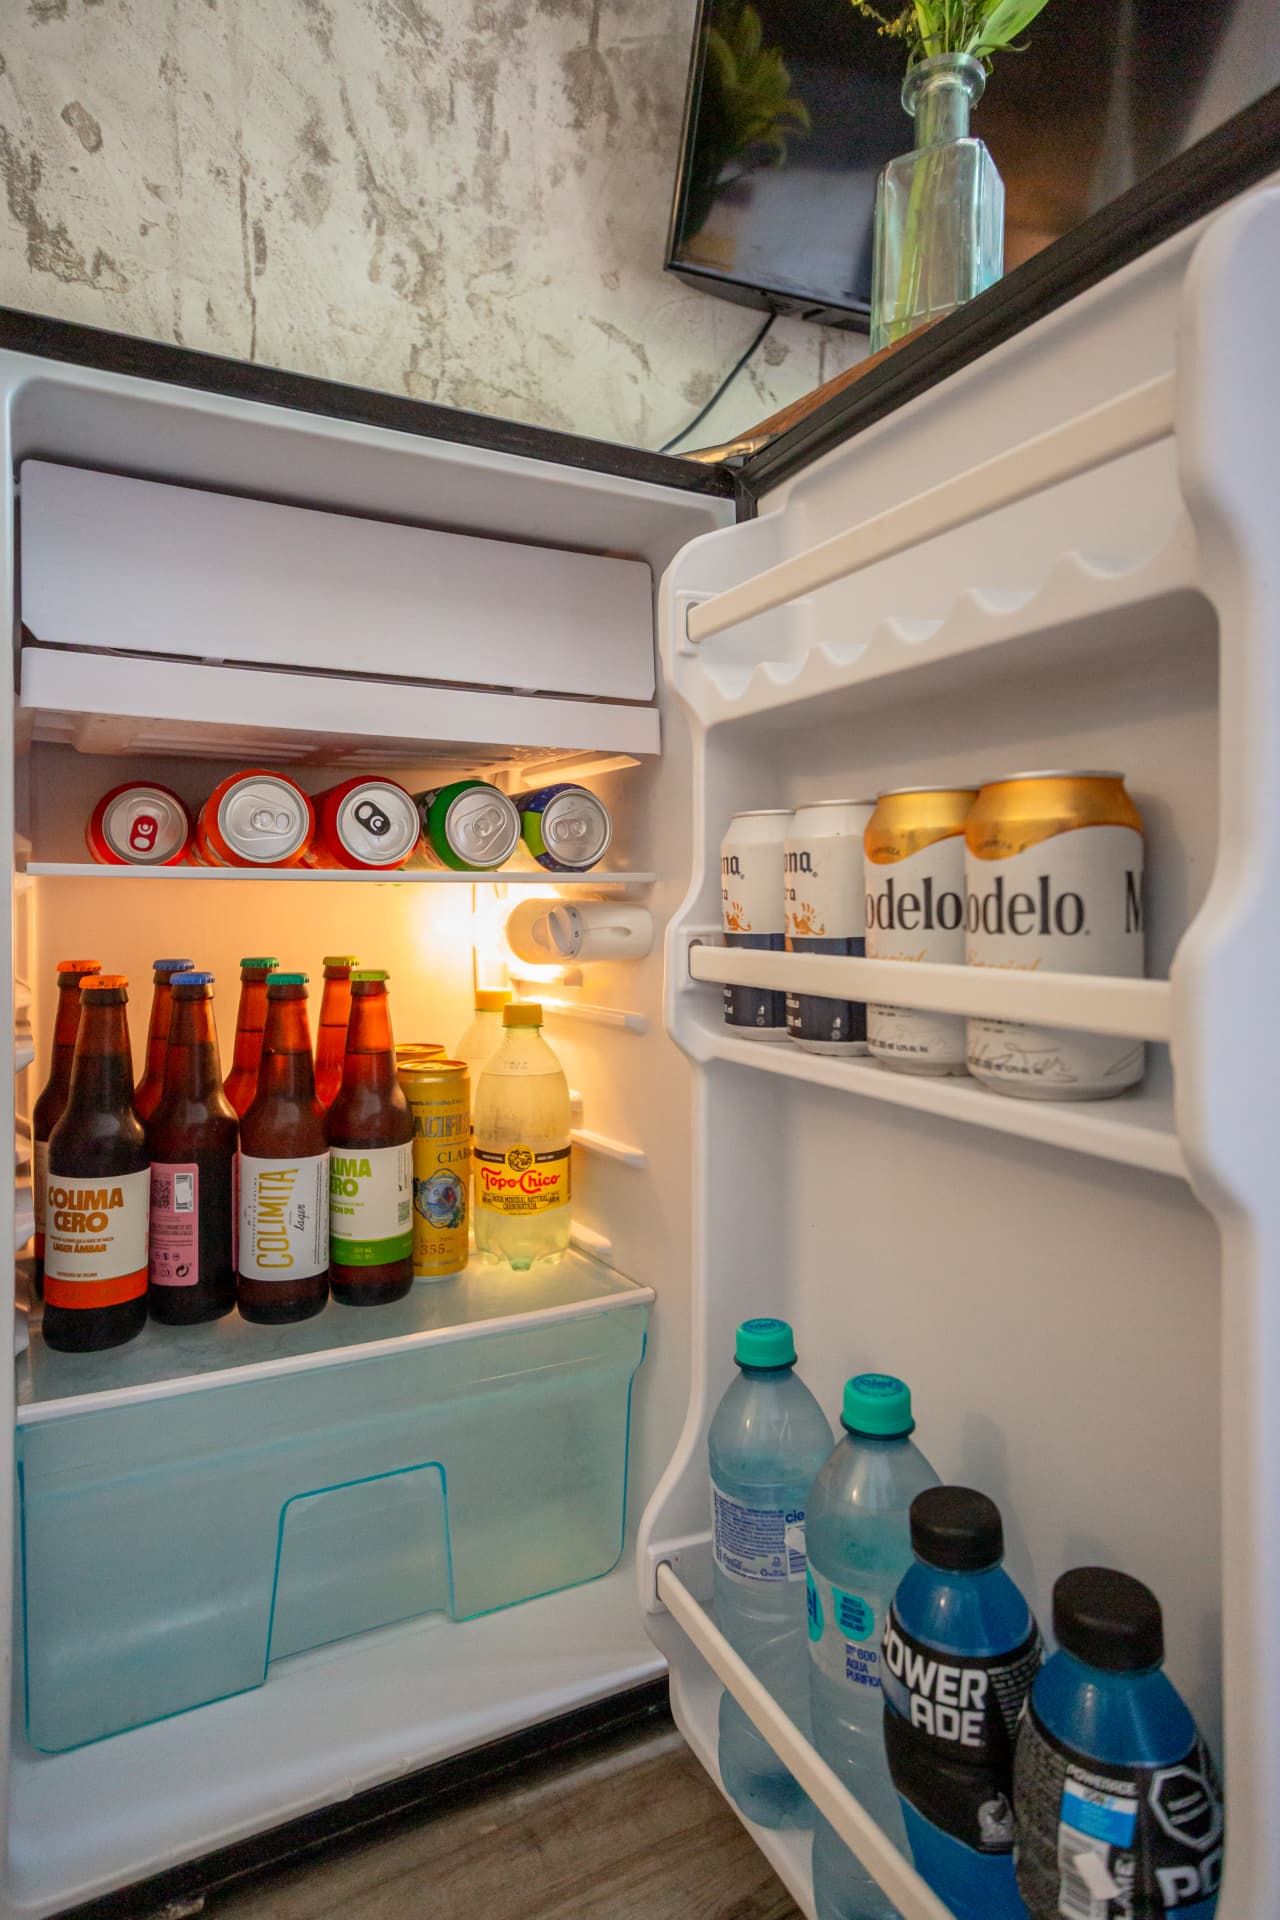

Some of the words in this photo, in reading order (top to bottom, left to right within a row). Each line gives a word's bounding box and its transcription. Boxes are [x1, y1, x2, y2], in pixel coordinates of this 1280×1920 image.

[481, 1167, 518, 1190] Topo
[519, 1170, 560, 1194] Chico
[48, 1187, 124, 1211] COLIMA
[54, 1211, 108, 1232] CERO
[256, 1168, 299, 1268] COLIMITA
[910, 1692, 987, 1747] ADE
